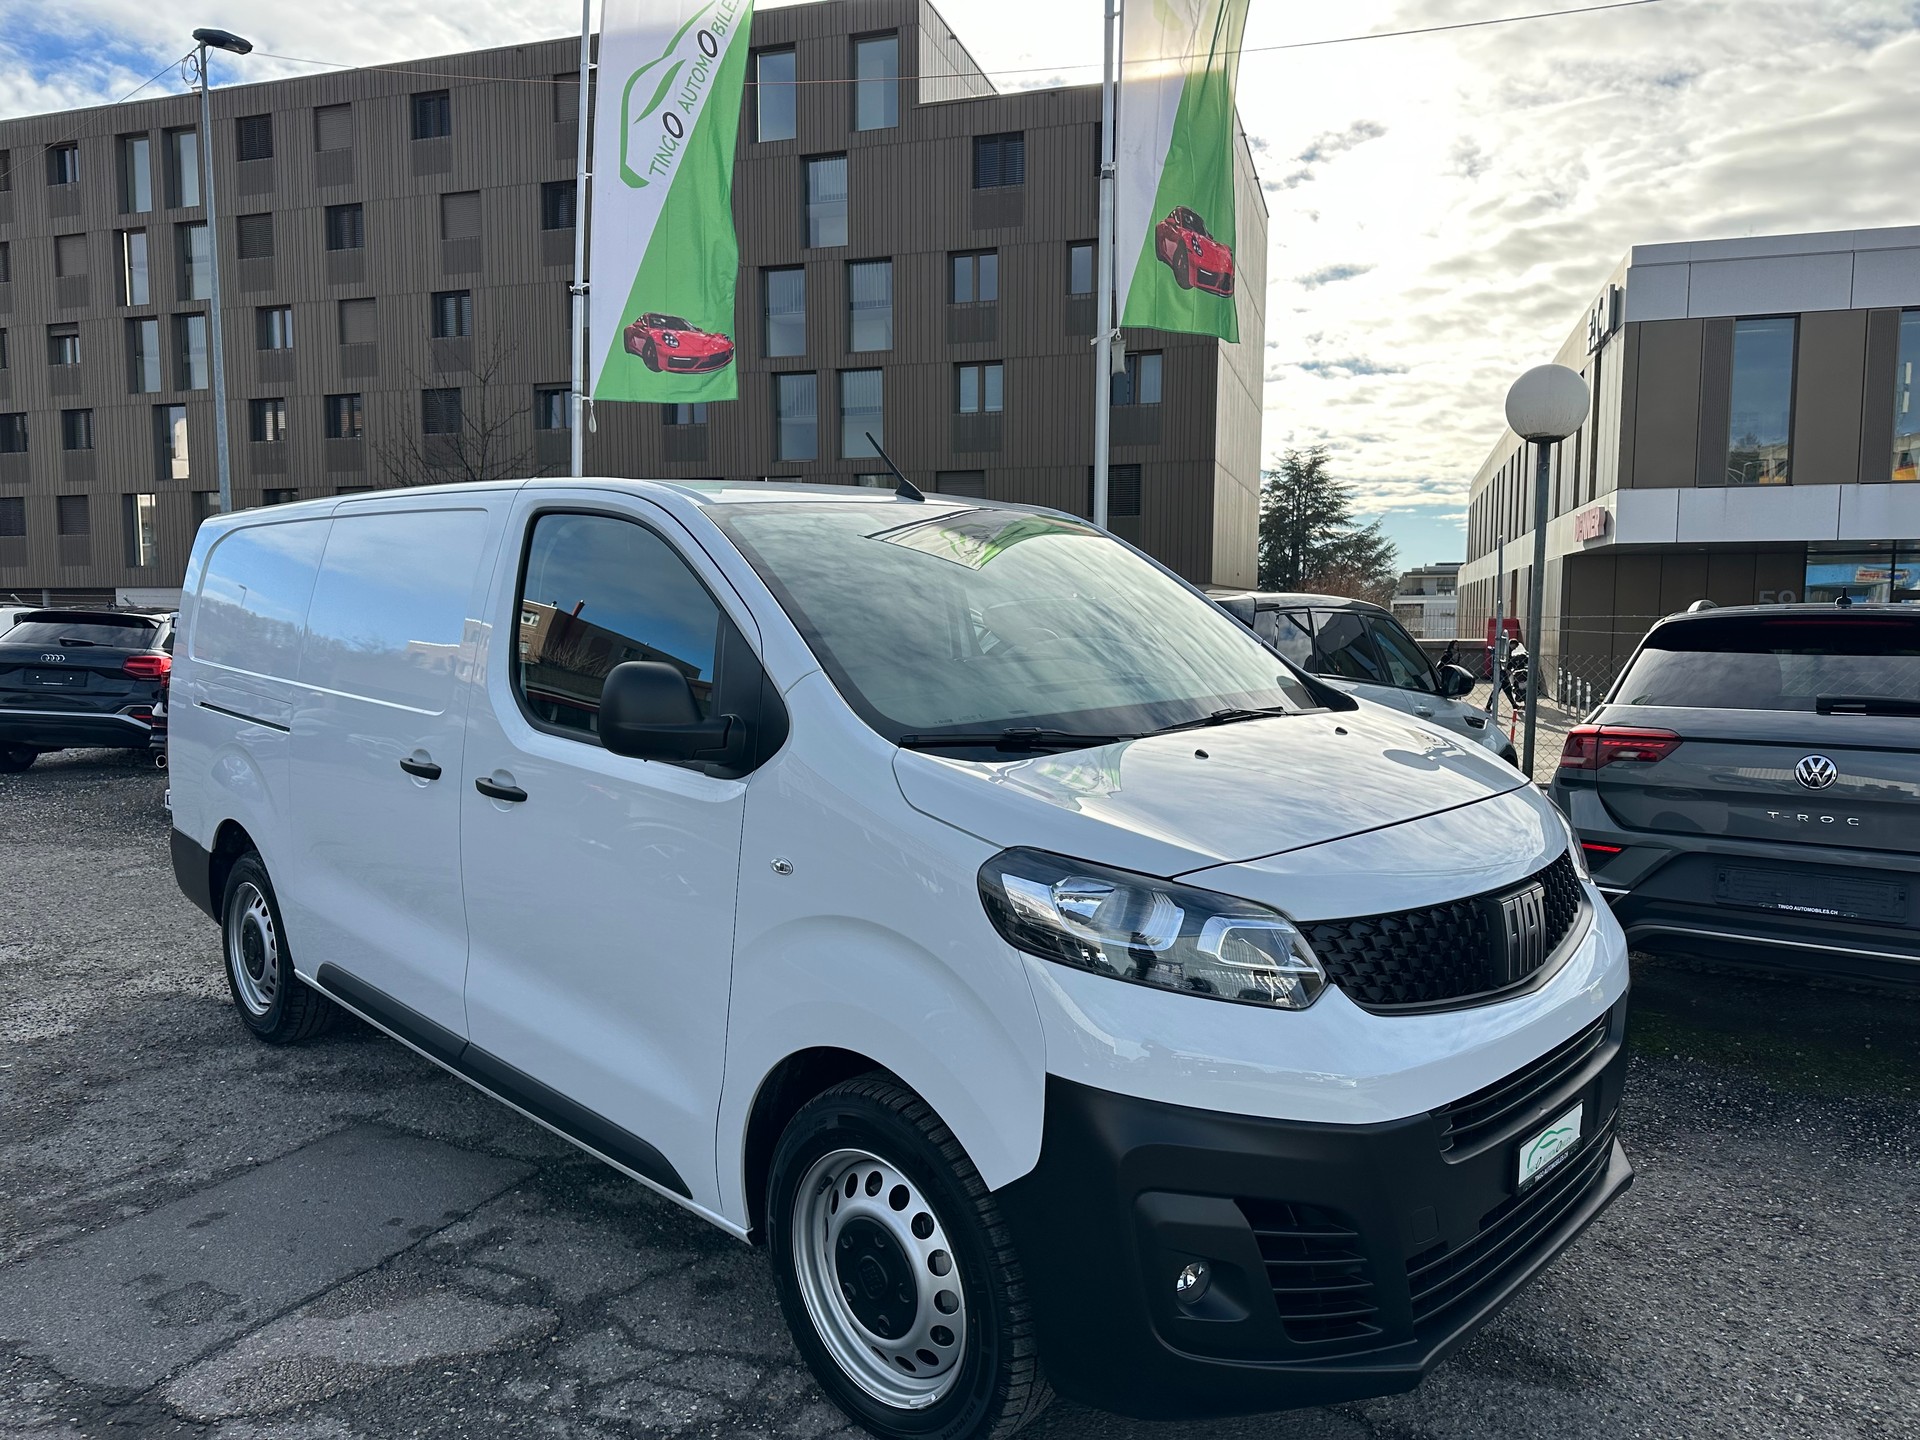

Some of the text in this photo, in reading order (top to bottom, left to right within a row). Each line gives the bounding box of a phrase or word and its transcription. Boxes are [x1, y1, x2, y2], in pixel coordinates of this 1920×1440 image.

[649, 111, 684, 176] TINGO
[1767, 811, 1859, 826] T-ROC
[1502, 887, 1546, 980] FIAT
